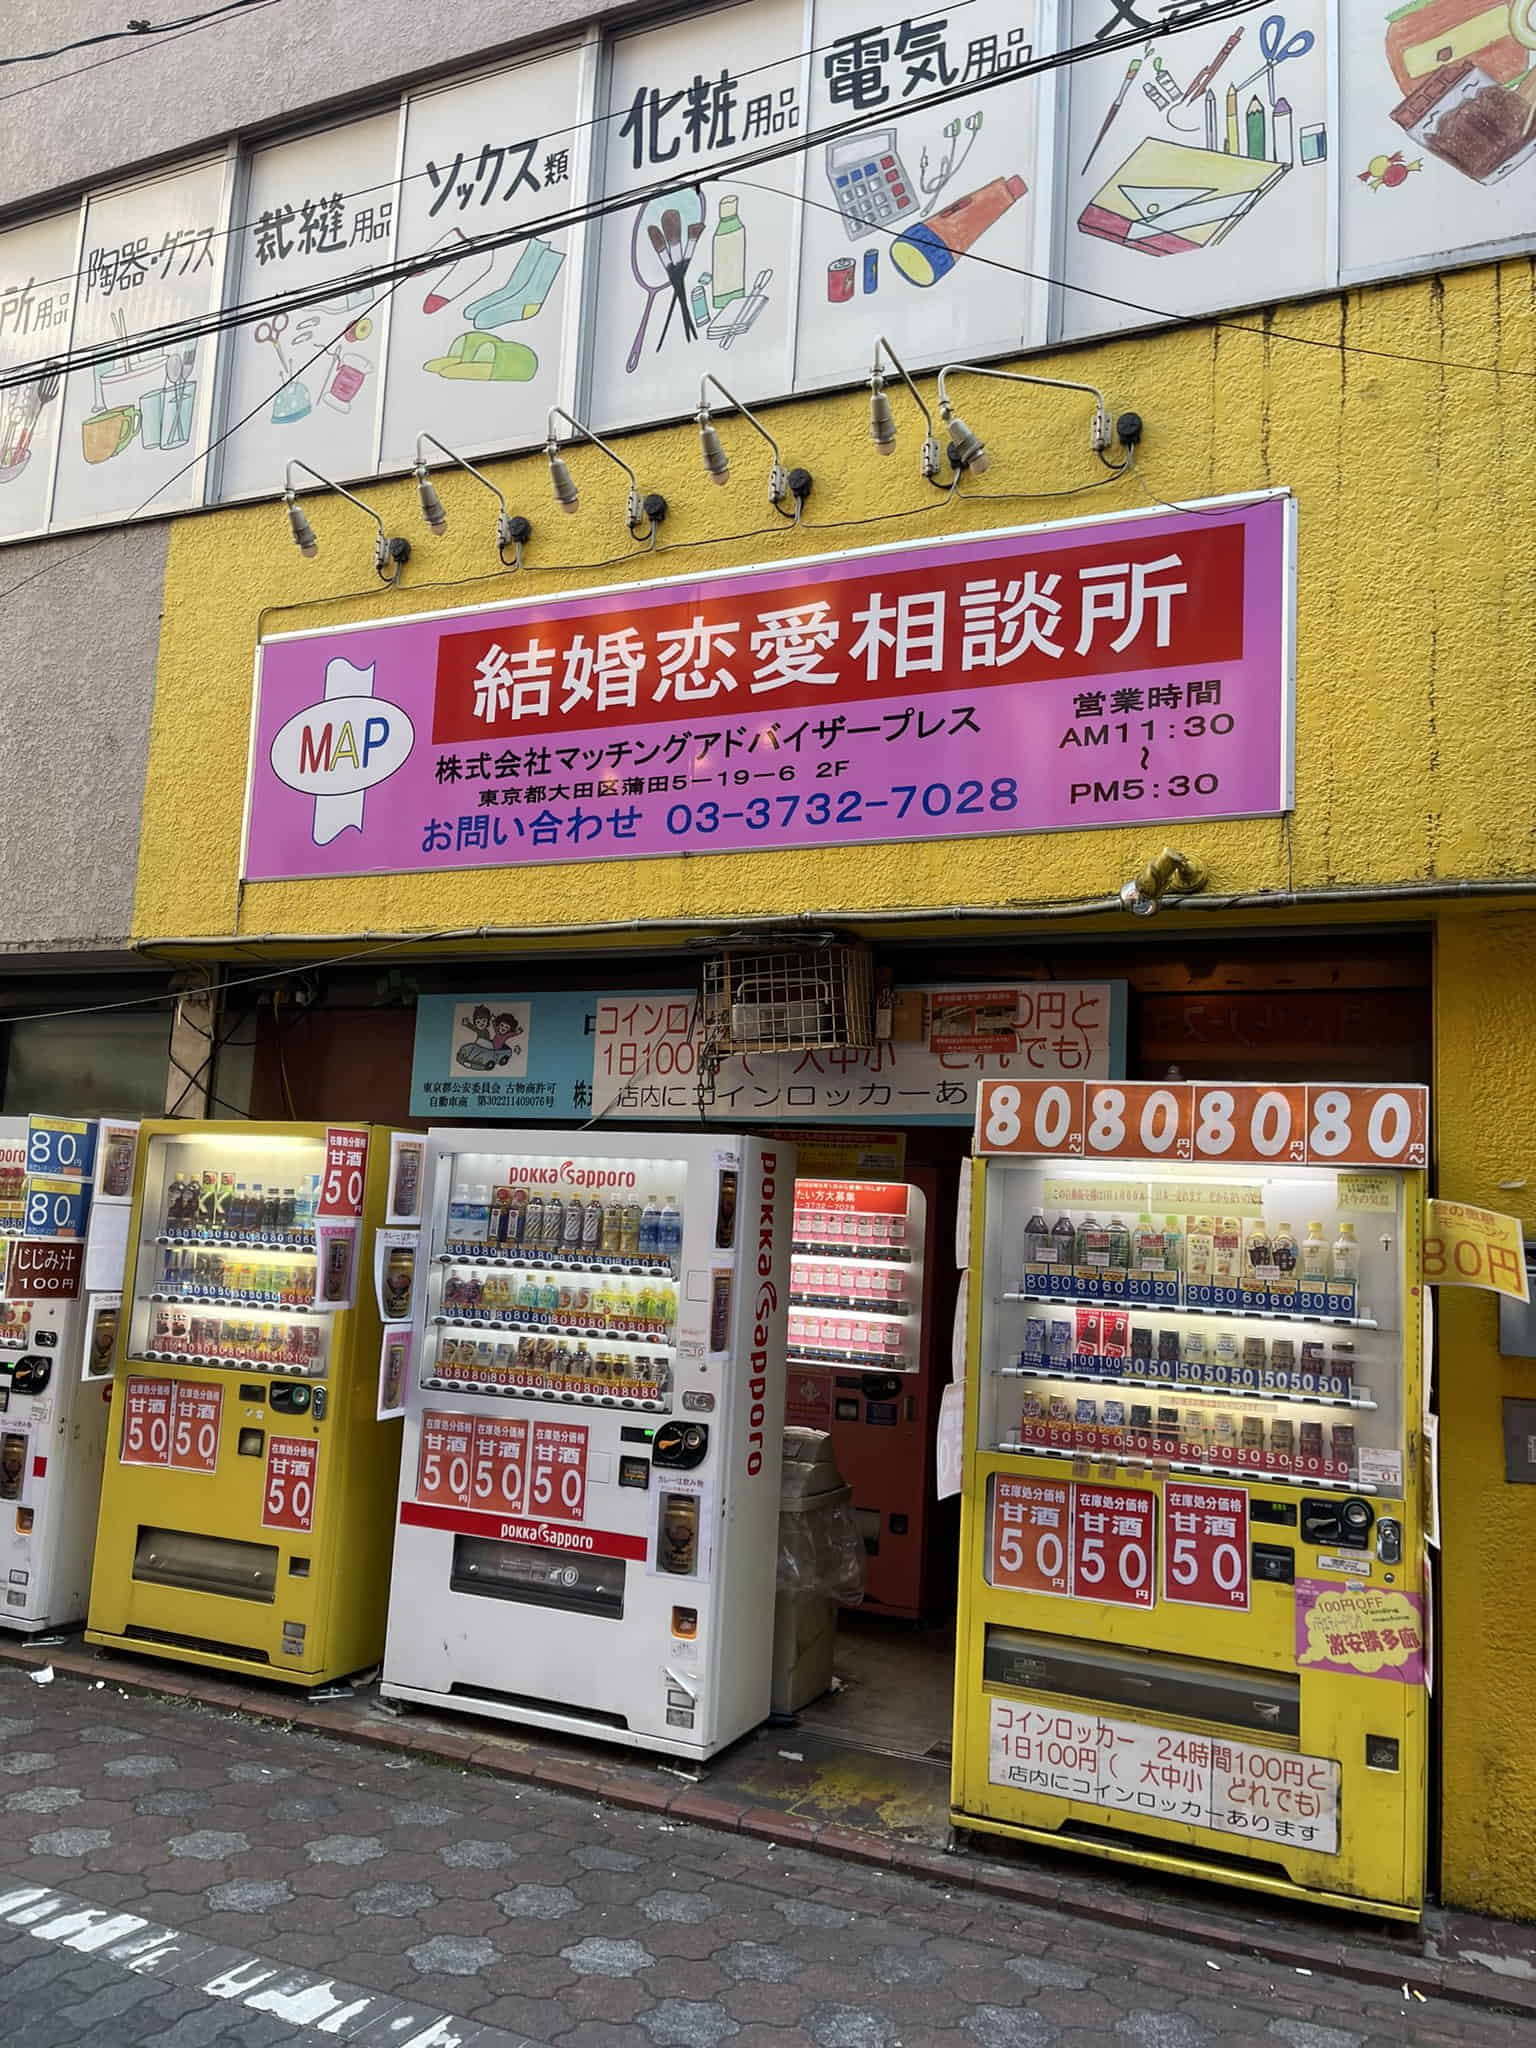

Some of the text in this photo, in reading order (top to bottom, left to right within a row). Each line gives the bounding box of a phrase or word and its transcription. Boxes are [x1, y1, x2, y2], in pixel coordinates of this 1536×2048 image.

[824, 18, 1033, 110] 電気用品
[619, 69, 799, 170] 化粧用品
[426, 139, 570, 217] ソックス類
[254, 191, 394, 266] 裁縫用品
[473, 553, 1187, 723] 結婚恋愛相談所
[1072, 679, 1222, 717] 営業時間
[435, 705, 981, 784] 株式会社マッチングアドバイザープレス
[1059, 712, 1235, 748] AM11:30
[298, 716, 390, 774] MAP
[815, 760, 850, 779] 2F
[1069, 773, 1219, 804] PM5:30
[421, 777, 1019, 852] お問い合わせ 03-3732-7028
[329, 1149, 363, 1167] 甘酒
[19, 1277, 73, 1289] 100円
[1026, 1275, 1352, 1311] 80 80 60 60 80 80 80 80 60 60 80 80
[513, 1310, 529, 1320] 80
[532, 1312, 547, 1322] 80
[472, 1370, 487, 1380] 80
[490, 1371, 506, 1382] 80
[527, 1375, 542, 1386] 80
[583, 1383, 599, 1393] 80
[622, 1386, 639, 1396] 80
[641, 1387, 658, 1397] 80
[1073, 1355, 1094, 1367] 100
[1099, 1357, 1121, 1368] 100
[1124, 1358, 1145, 1375] 50
[1149, 1360, 1170, 1376] 50
[1180, 1362, 1201, 1379] 50
[1204, 1366, 1227, 1382] 50
[1231, 1368, 1253, 1384] 50
[1265, 1371, 1288, 1389] 50
[1291, 1373, 1314, 1390] 50
[1318, 1376, 1342, 1393] 50
[128, 1398, 167, 1414] 甘酒
[178, 1403, 217, 1420] 甘酒
[423, 1433, 468, 1453] 甘酒
[475, 1438, 521, 1459] 甘酒
[535, 1444, 581, 1465] 甘酒
[1025, 1426, 1046, 1438] 50
[1051, 1429, 1071, 1442] 50
[1075, 1431, 1096, 1443] 50
[1102, 1433, 1122, 1446] 50
[1126, 1435, 1147, 1448] 50
[1152, 1439, 1174, 1452] 50
[1180, 1443, 1202, 1456] 50
[1209, 1445, 1232, 1458] 50
[1237, 1449, 1260, 1462] 50
[1266, 1452, 1289, 1464] 50
[1295, 1456, 1319, 1469] 50
[1324, 1460, 1349, 1474] 50
[270, 1457, 311, 1477] 甘酒
[1000, 1483, 1066, 1504] 在庫処分価格
[1079, 1493, 1149, 1513] 在庫処分価格
[1169, 1492, 1242, 1513] 在庫処分価格
[999, 1502, 1061, 1528] 甘酒
[1079, 1511, 1143, 1538] 甘酒
[1169, 1511, 1237, 1538] 甘酒
[997, 1706, 1327, 1791] コインロッカー 24時間100円と
[1140, 1760, 1203, 1793] 大中小
[1007, 1765, 1320, 1843] 店内にコインロッカーあります
